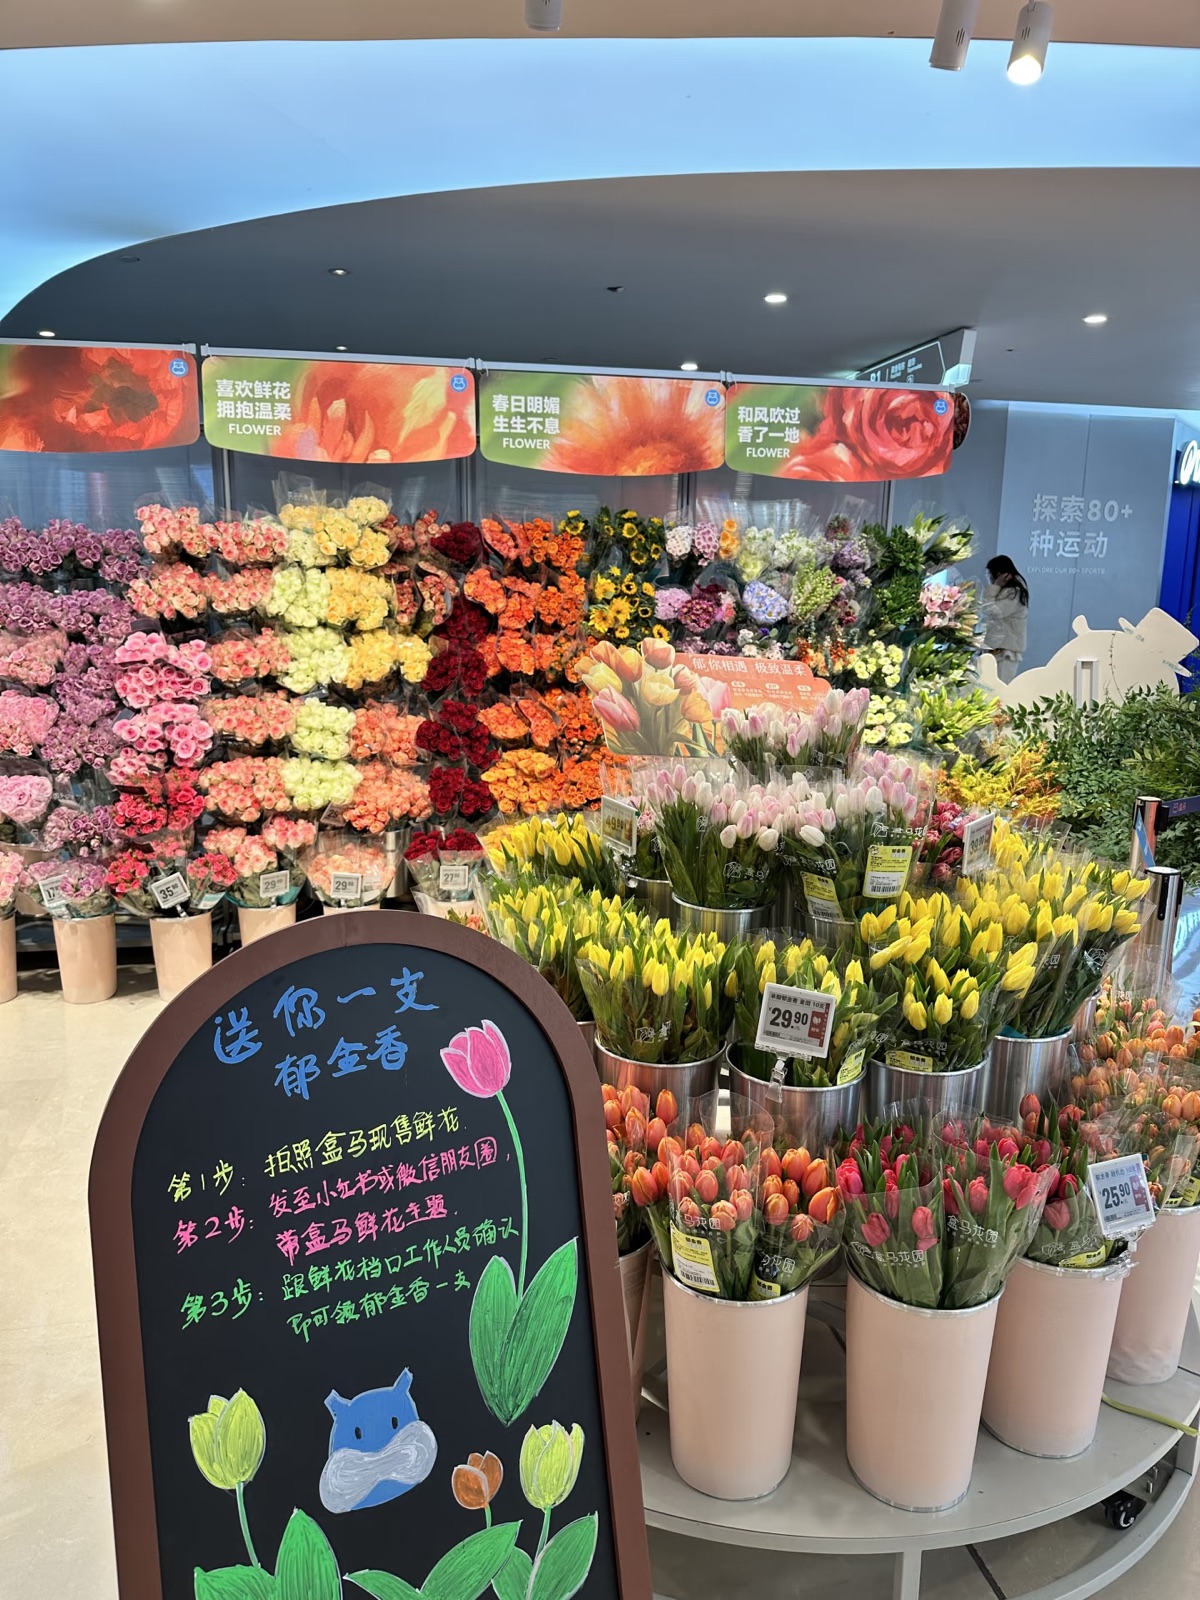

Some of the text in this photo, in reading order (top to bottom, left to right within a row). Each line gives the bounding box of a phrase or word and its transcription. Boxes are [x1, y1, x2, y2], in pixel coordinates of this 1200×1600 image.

[215, 379, 291, 399] 喜欢鲜花
[216, 400, 292, 420] 拥抱温柔
[492, 394, 560, 414] 春日明媚
[492, 415, 560, 435] 生生不息
[737, 406, 801, 424] 和风吹过
[228, 423, 282, 436] FLOWER
[737, 426, 800, 443] 香了一地
[502, 438, 551, 449] FLOWER
[746, 447, 790, 458] FLOWER
[1032, 493, 1133, 523] 探索80+
[1029, 529, 1109, 559] 种运动
[754, 662, 807, 676] 极致温柔
[212, 966, 441, 1065] 送你一支
[273, 1024, 409, 1101] 郁金香
[282, 1216, 520, 1301] 跟鲜花档口工作人员确认
[286, 1268, 472, 1343] 即可领郁金香一支
